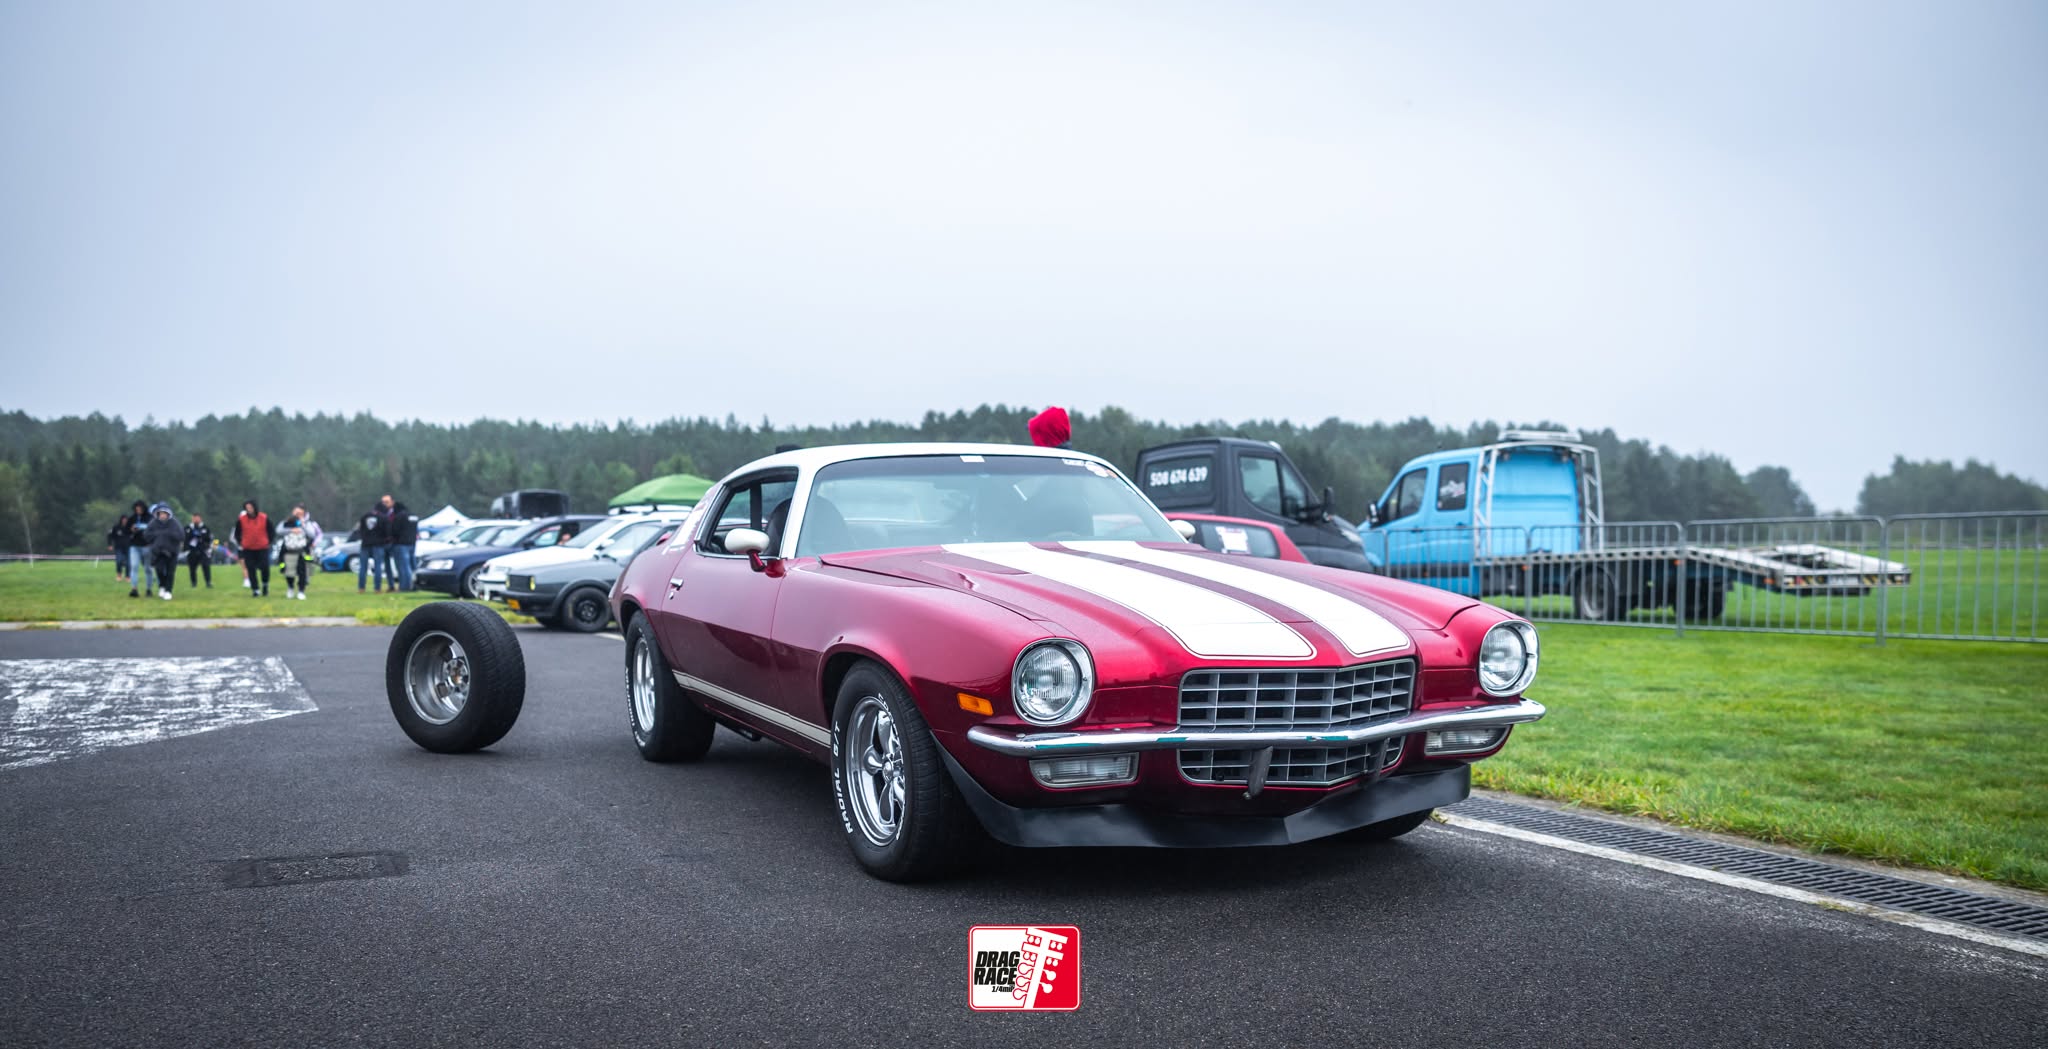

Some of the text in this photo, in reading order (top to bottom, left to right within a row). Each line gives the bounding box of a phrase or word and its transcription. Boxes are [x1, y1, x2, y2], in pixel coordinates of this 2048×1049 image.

[1150, 471, 1169, 486] 508
[1188, 466, 1208, 482] 639
[834, 767, 854, 834] RADIAL
